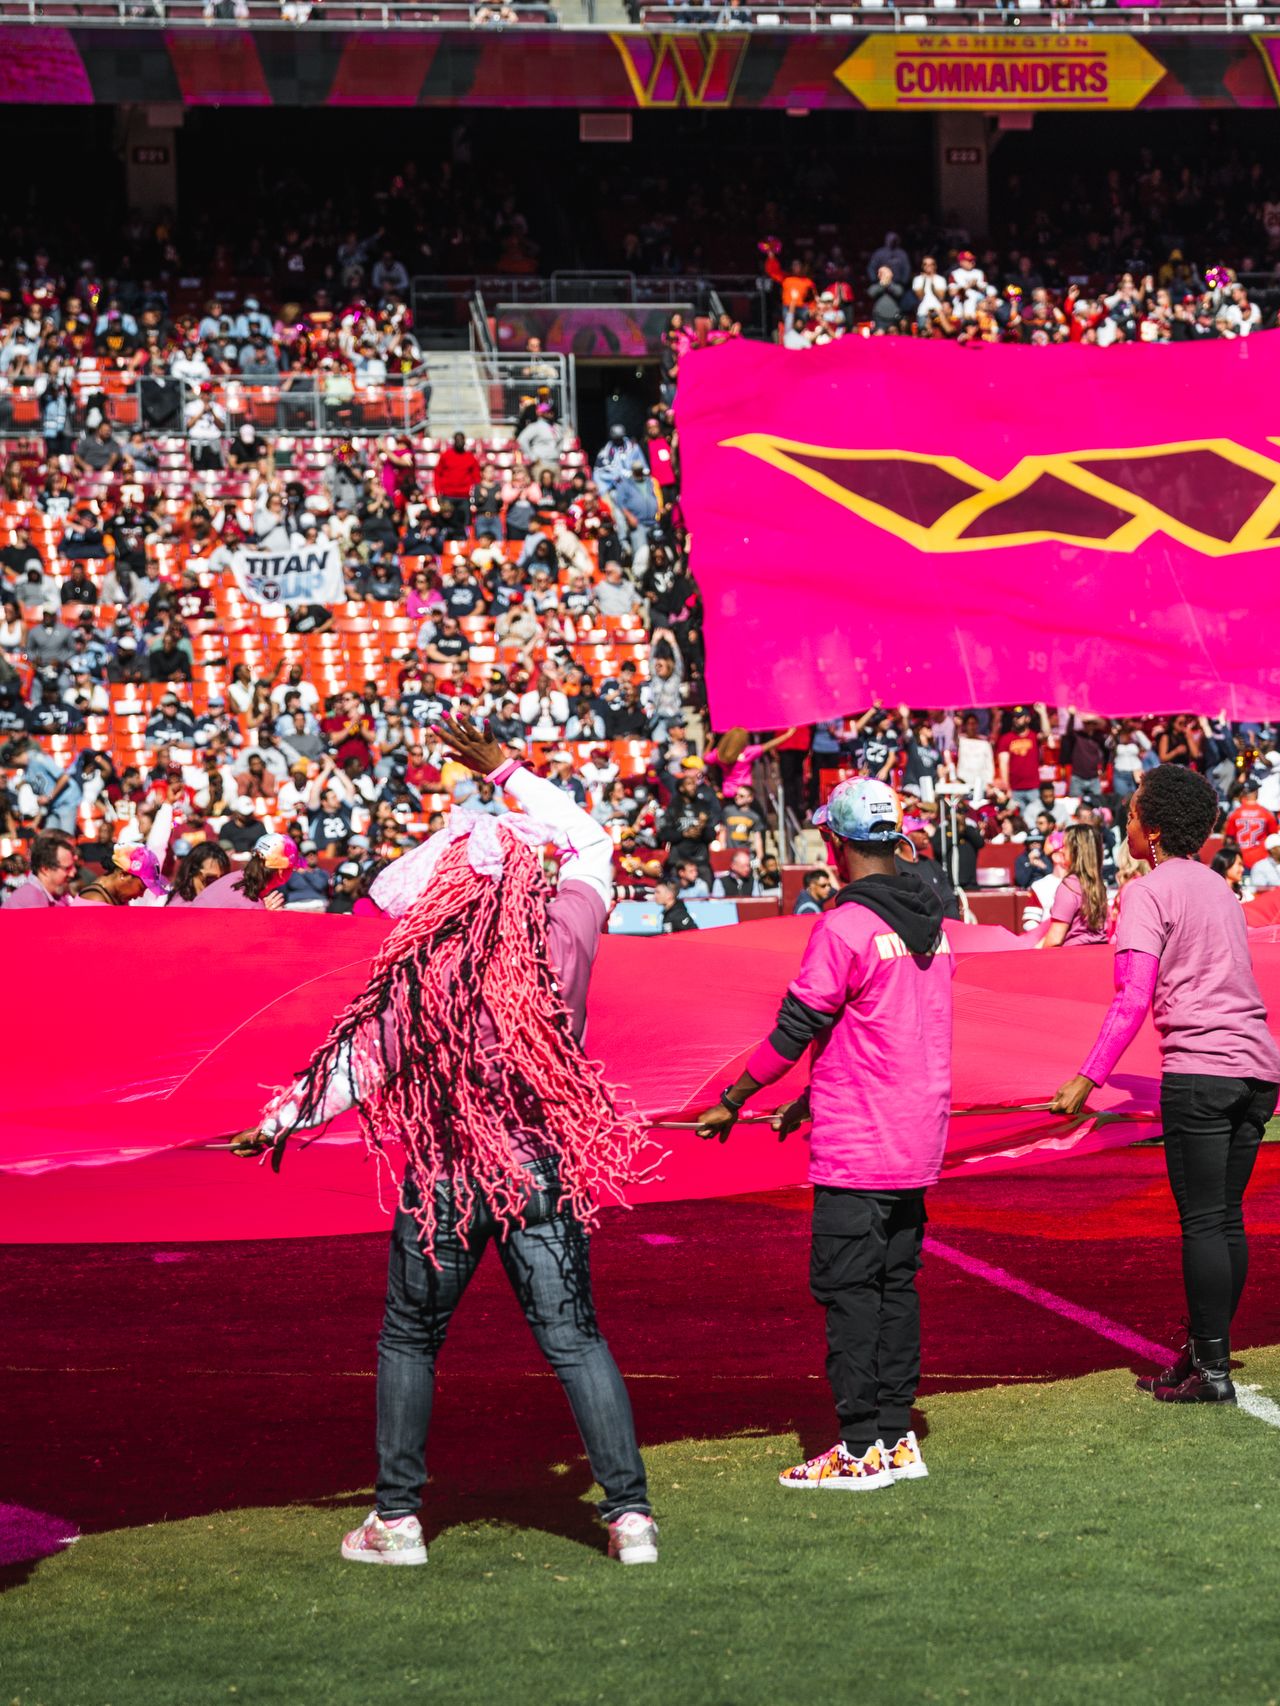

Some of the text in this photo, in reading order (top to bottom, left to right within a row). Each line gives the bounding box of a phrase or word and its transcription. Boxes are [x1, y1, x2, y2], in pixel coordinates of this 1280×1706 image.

[917, 37, 1088, 48] WASHINGTON
[896, 62, 1108, 93] COMMANDERS
[246, 551, 329, 576] TITAN
[280, 572, 324, 599] UP
